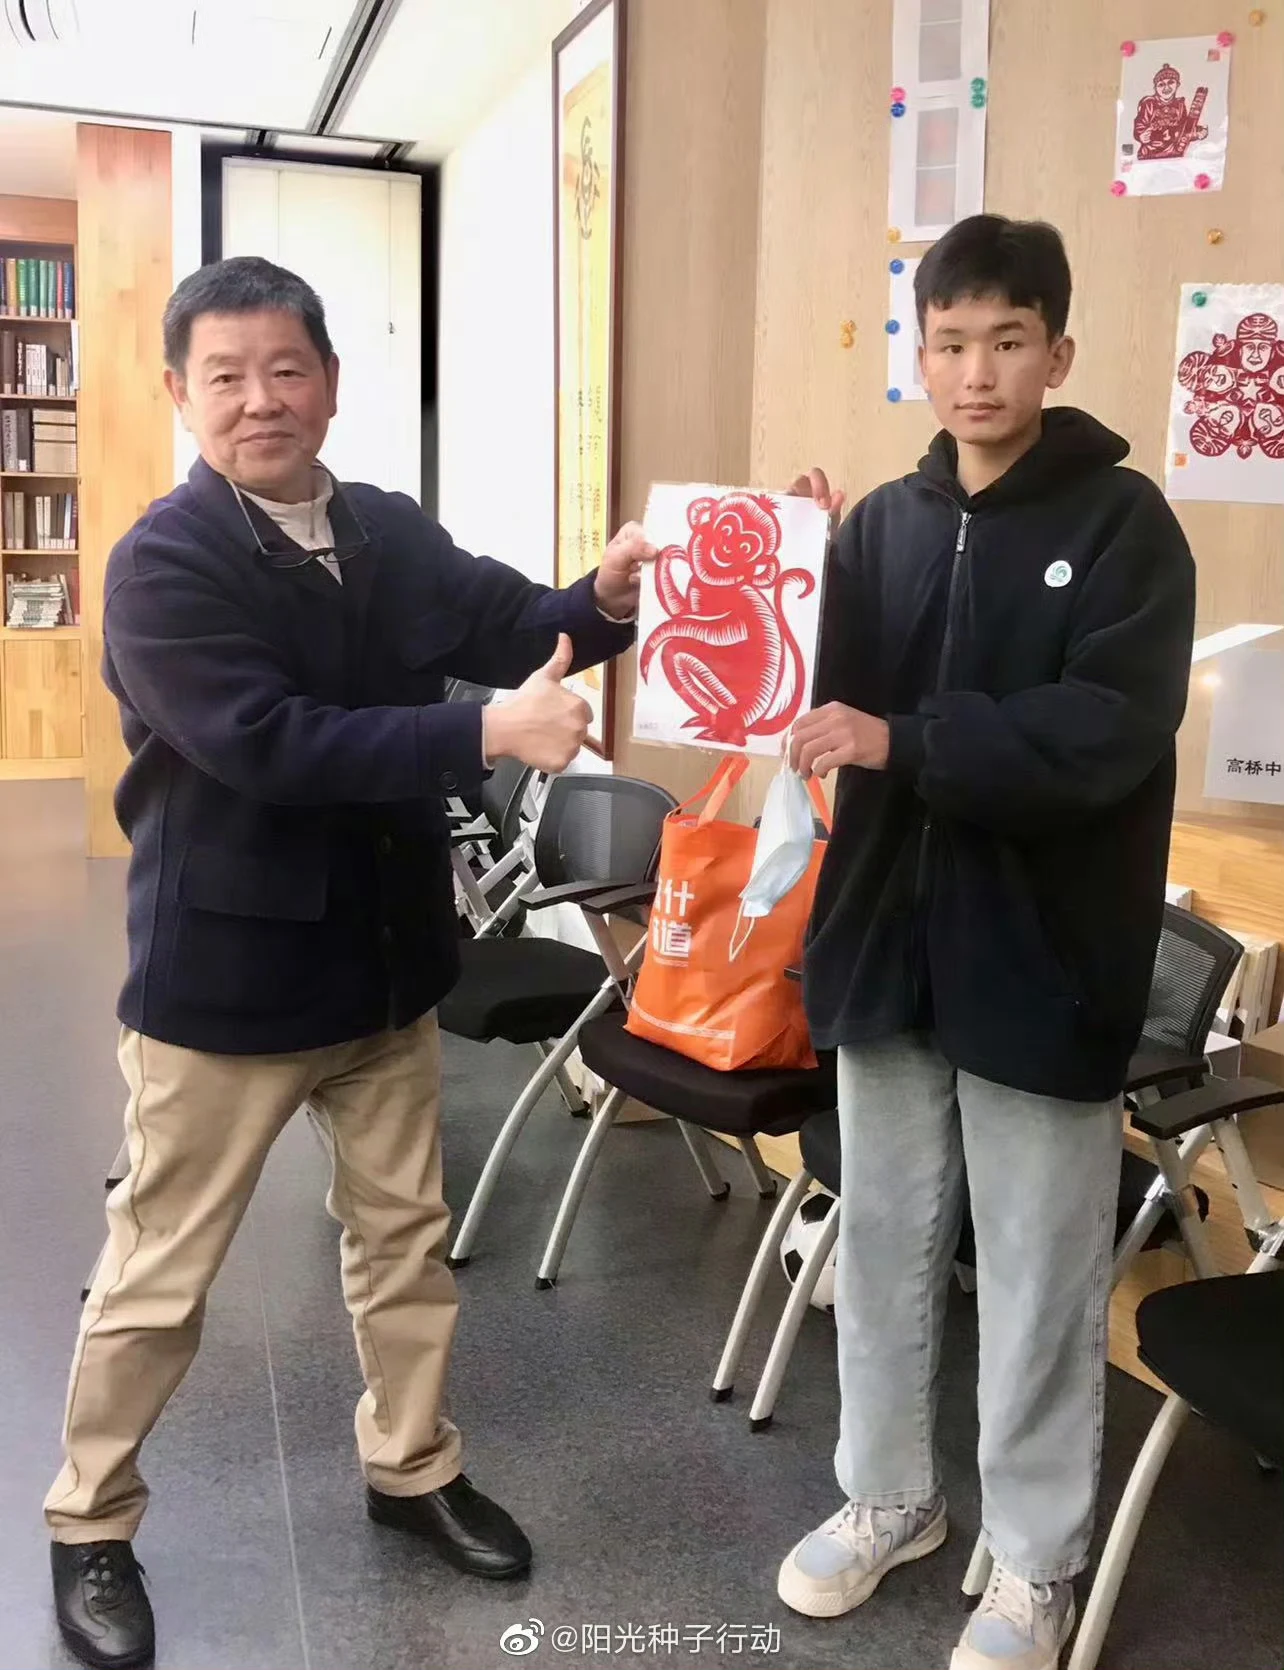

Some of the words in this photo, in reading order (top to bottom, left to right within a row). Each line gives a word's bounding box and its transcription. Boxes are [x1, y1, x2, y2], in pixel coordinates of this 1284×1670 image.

[1226, 757, 1282, 777] 高桥中
[652, 916, 692, 958] 道
